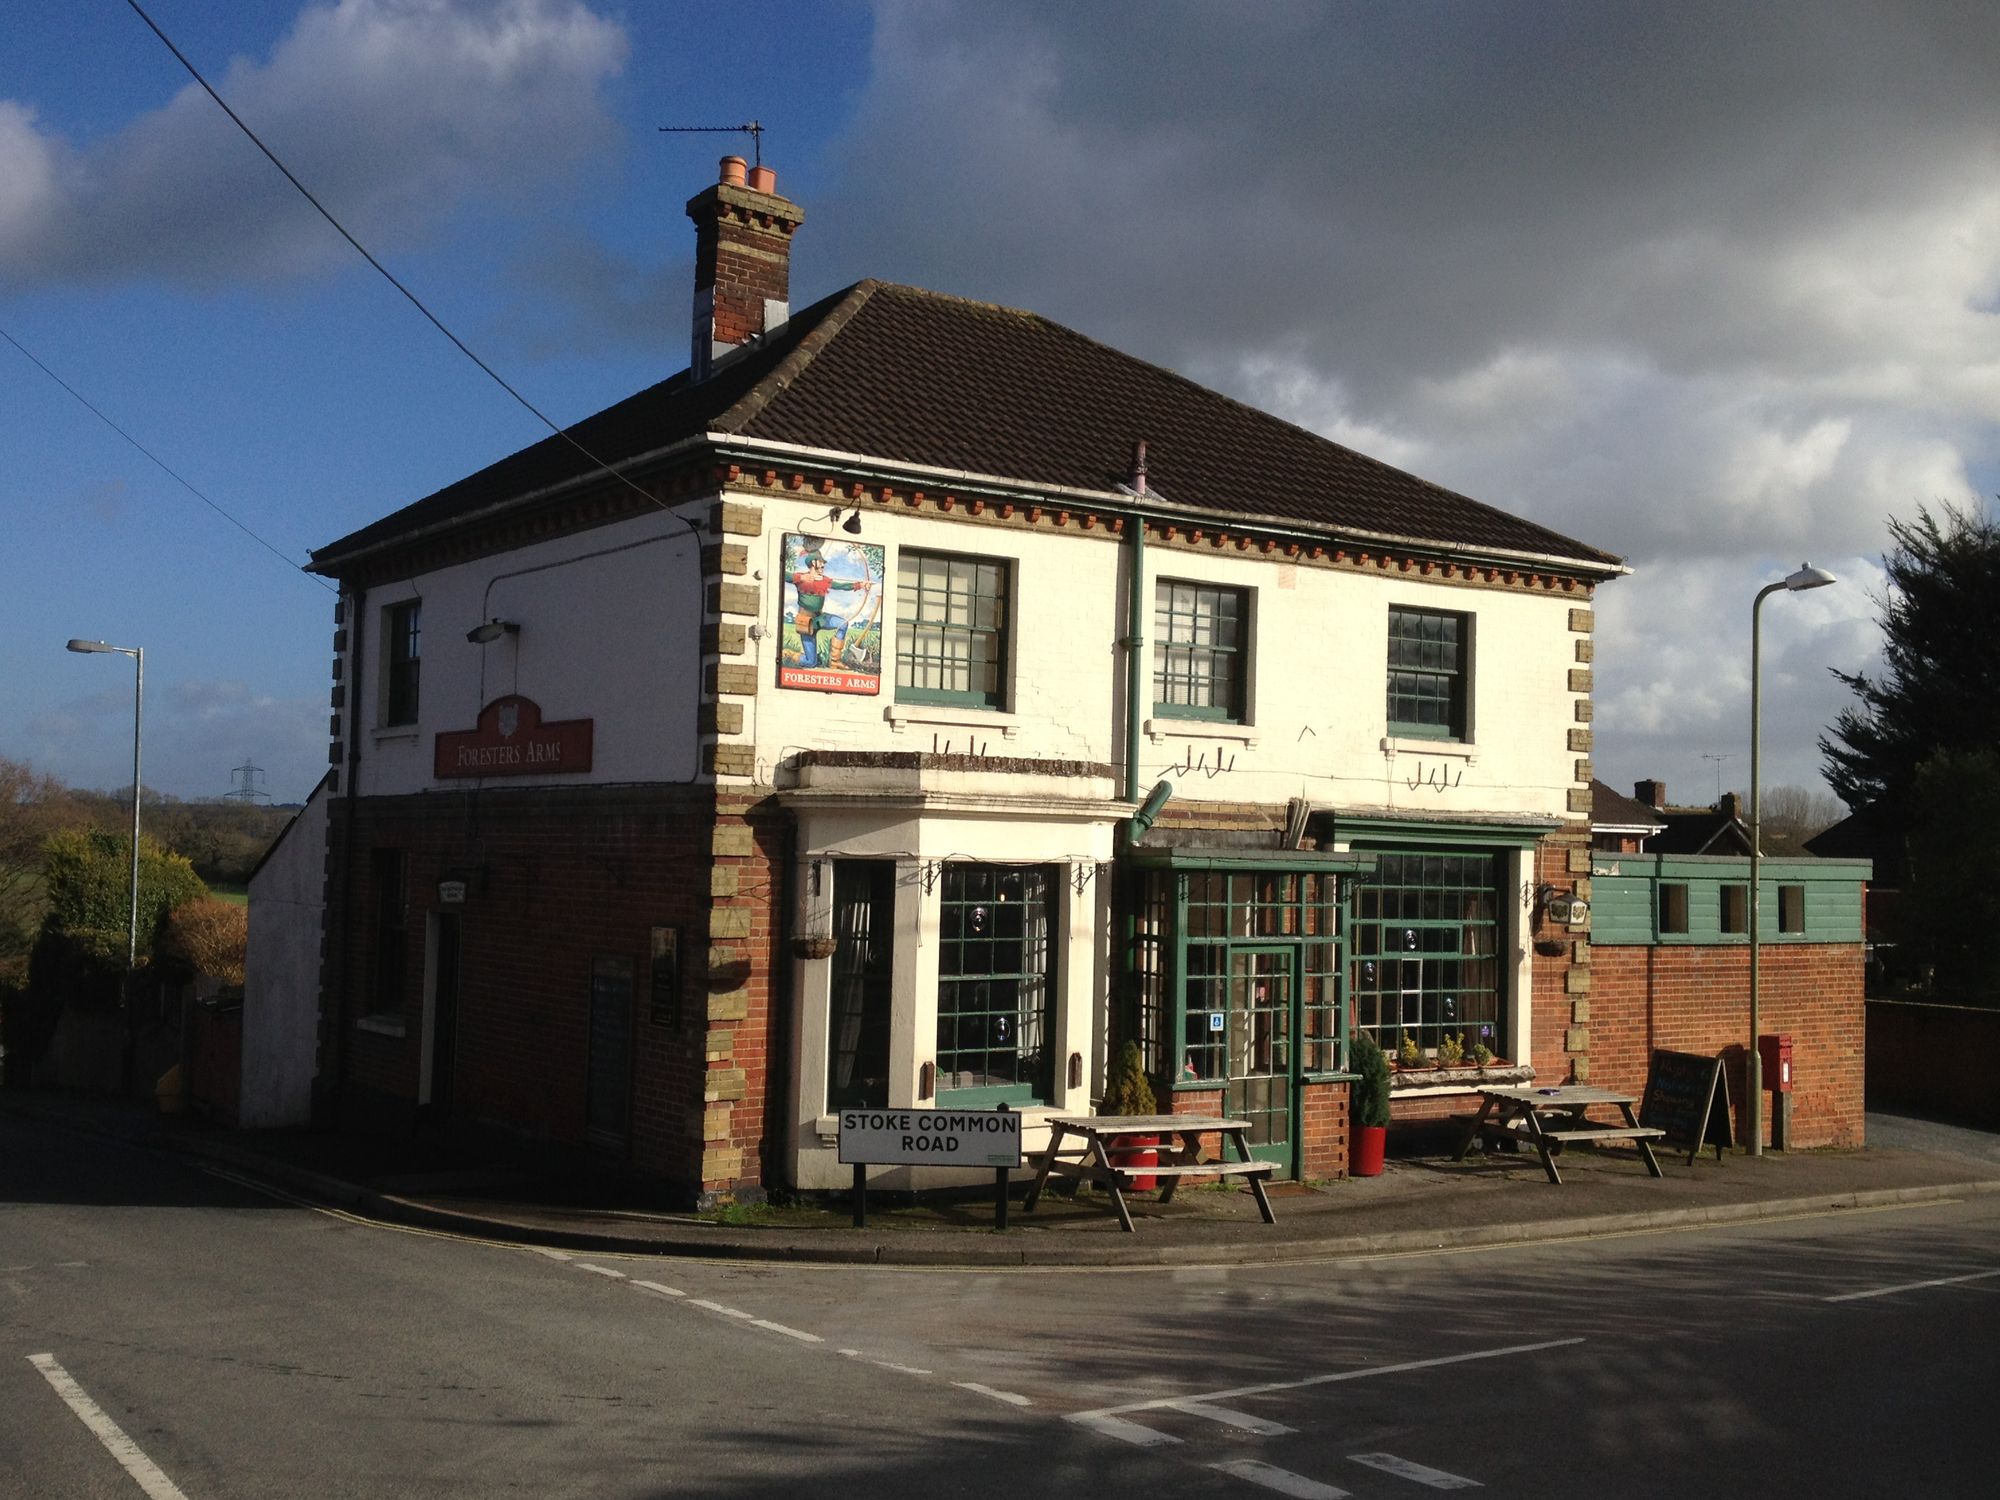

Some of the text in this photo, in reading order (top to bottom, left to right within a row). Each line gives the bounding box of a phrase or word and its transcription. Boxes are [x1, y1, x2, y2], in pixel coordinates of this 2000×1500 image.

[784, 672, 877, 689] FORESTERS ARMS
[457, 740, 561, 767] FORESTERS ARMS
[844, 1114, 1016, 1133] STOKE COMMON
[902, 1135, 959, 1152] ROAD
